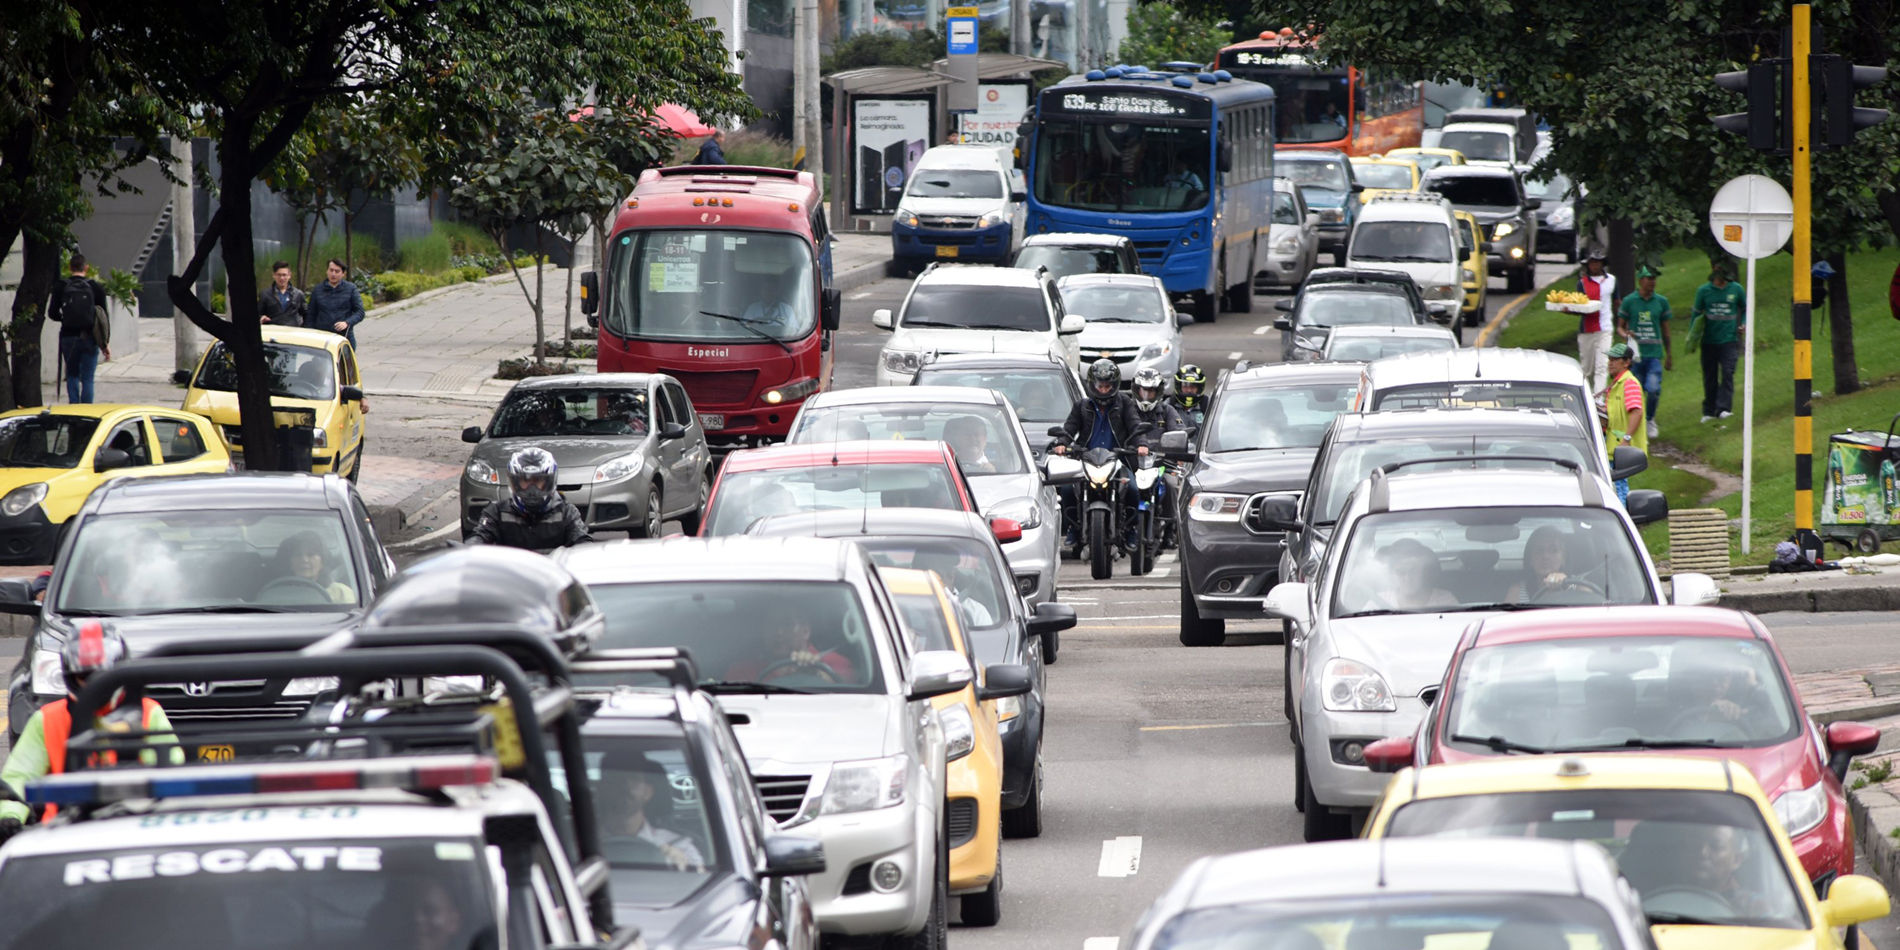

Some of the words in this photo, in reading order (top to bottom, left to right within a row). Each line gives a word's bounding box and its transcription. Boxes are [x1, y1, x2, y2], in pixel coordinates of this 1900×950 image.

[961, 131, 1014, 143] CIUDAD
[688, 346, 729, 358] Especial
[63, 847, 382, 886] RESCATE
